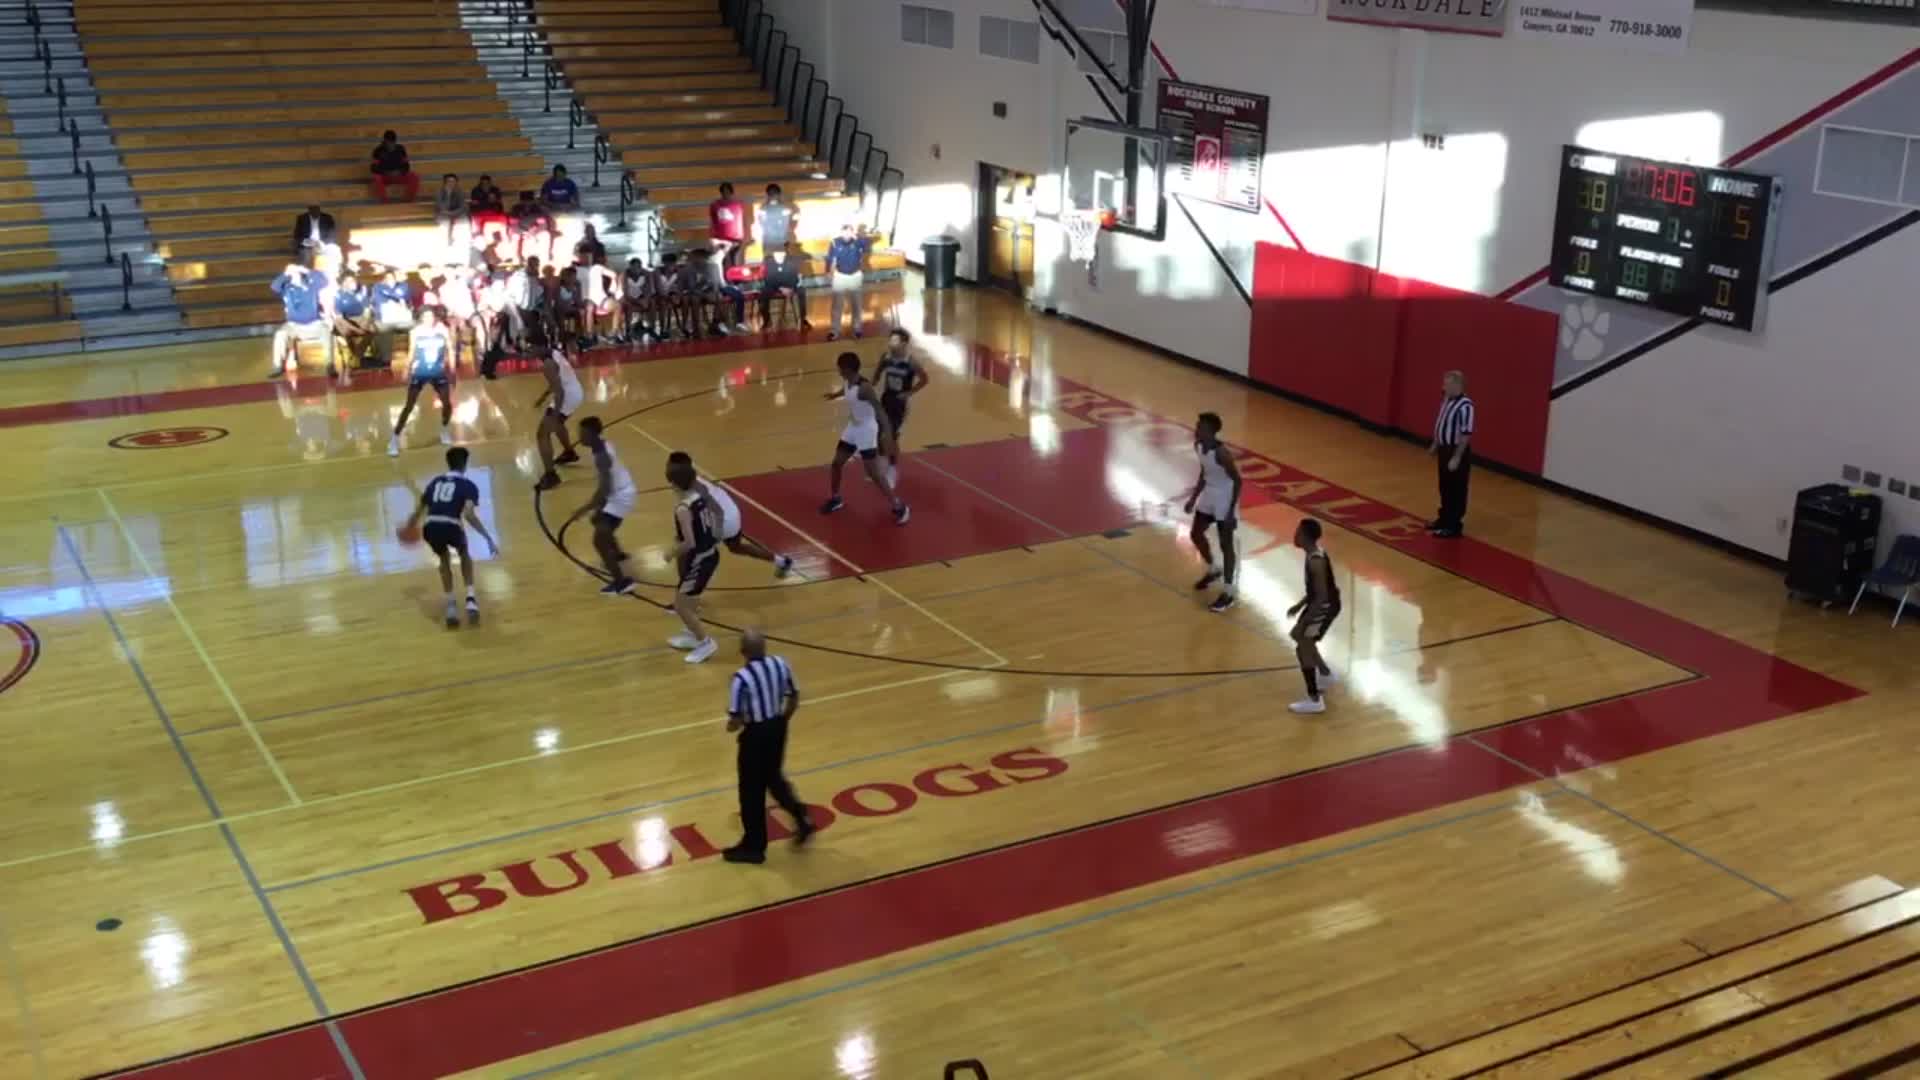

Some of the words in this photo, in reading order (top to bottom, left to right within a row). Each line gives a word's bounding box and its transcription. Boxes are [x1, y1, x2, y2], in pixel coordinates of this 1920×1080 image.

[1340, 0, 1494, 17] KDALE
[1609, 19, 1683, 39] 770-918-3000
[1167, 85, 1215, 103] ROCKDALE
[1217, 94, 1258, 110] COUNTY
[1206, 103, 1237, 116] SCHOOL
[1642, 164, 1698, 207] 7:06
[1711, 177, 1760, 198] HOME
[1058, 388, 1427, 542] ROCDALE
[432, 481, 457, 503] 10
